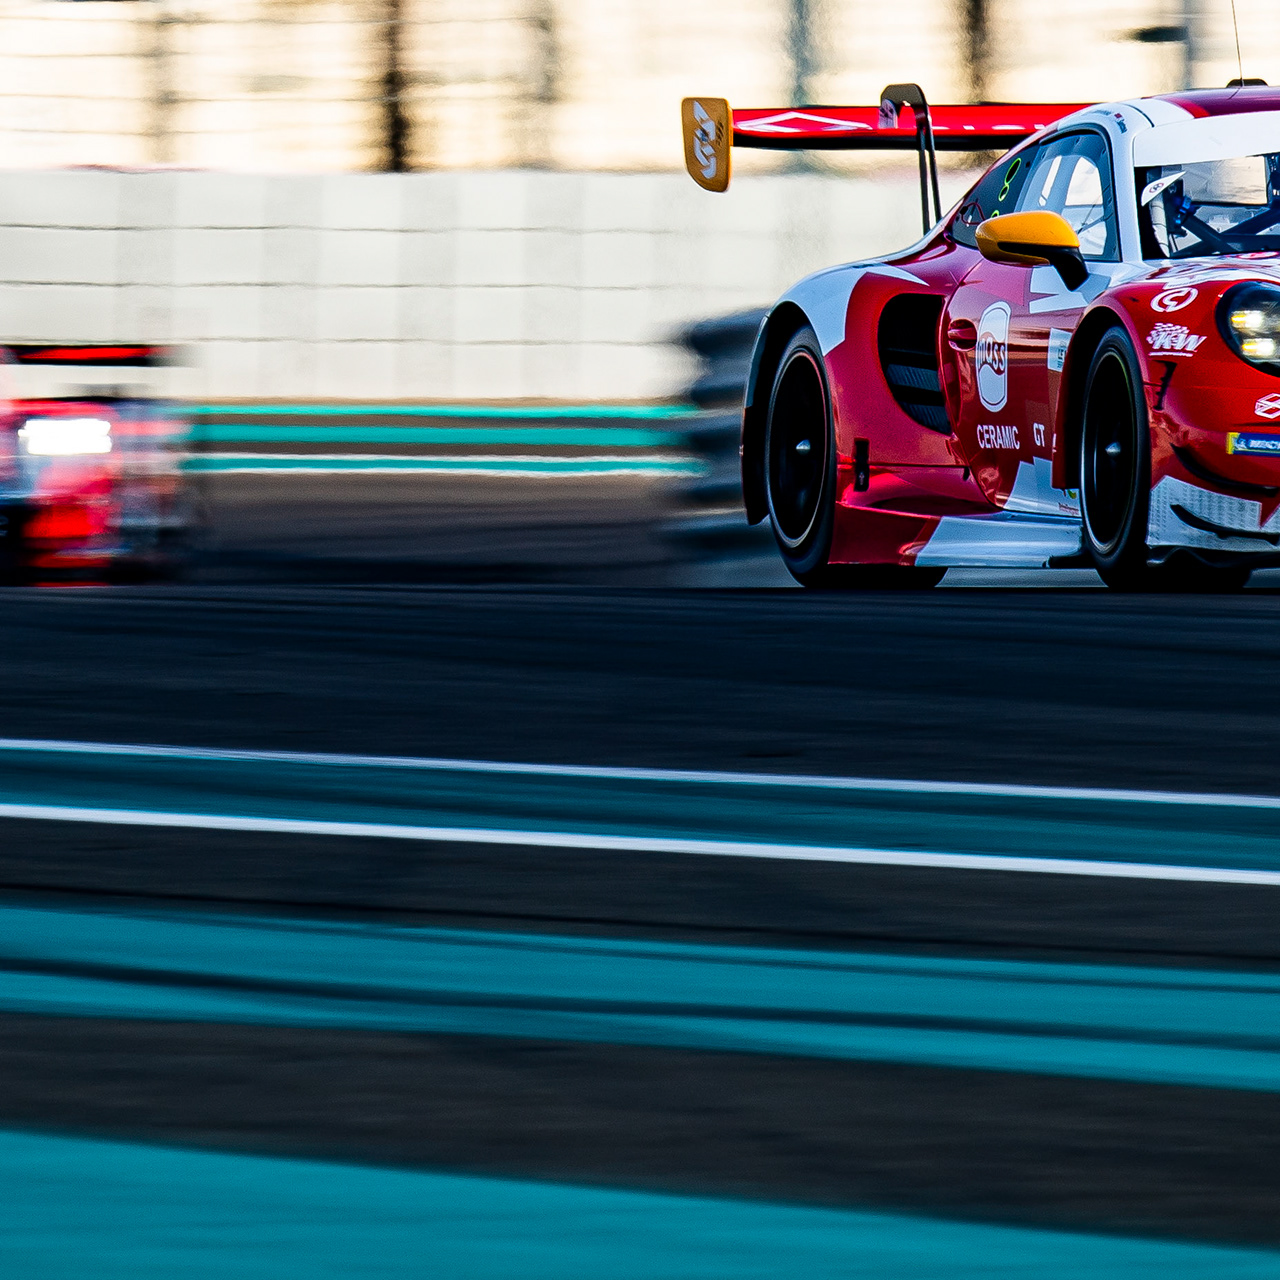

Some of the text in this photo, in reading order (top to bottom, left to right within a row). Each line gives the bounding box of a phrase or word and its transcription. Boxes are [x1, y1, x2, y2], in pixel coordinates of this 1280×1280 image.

[977, 336, 1006, 372] mass
[976, 424, 1021, 450] CERAMIC
[1032, 422, 1046, 448] GT
